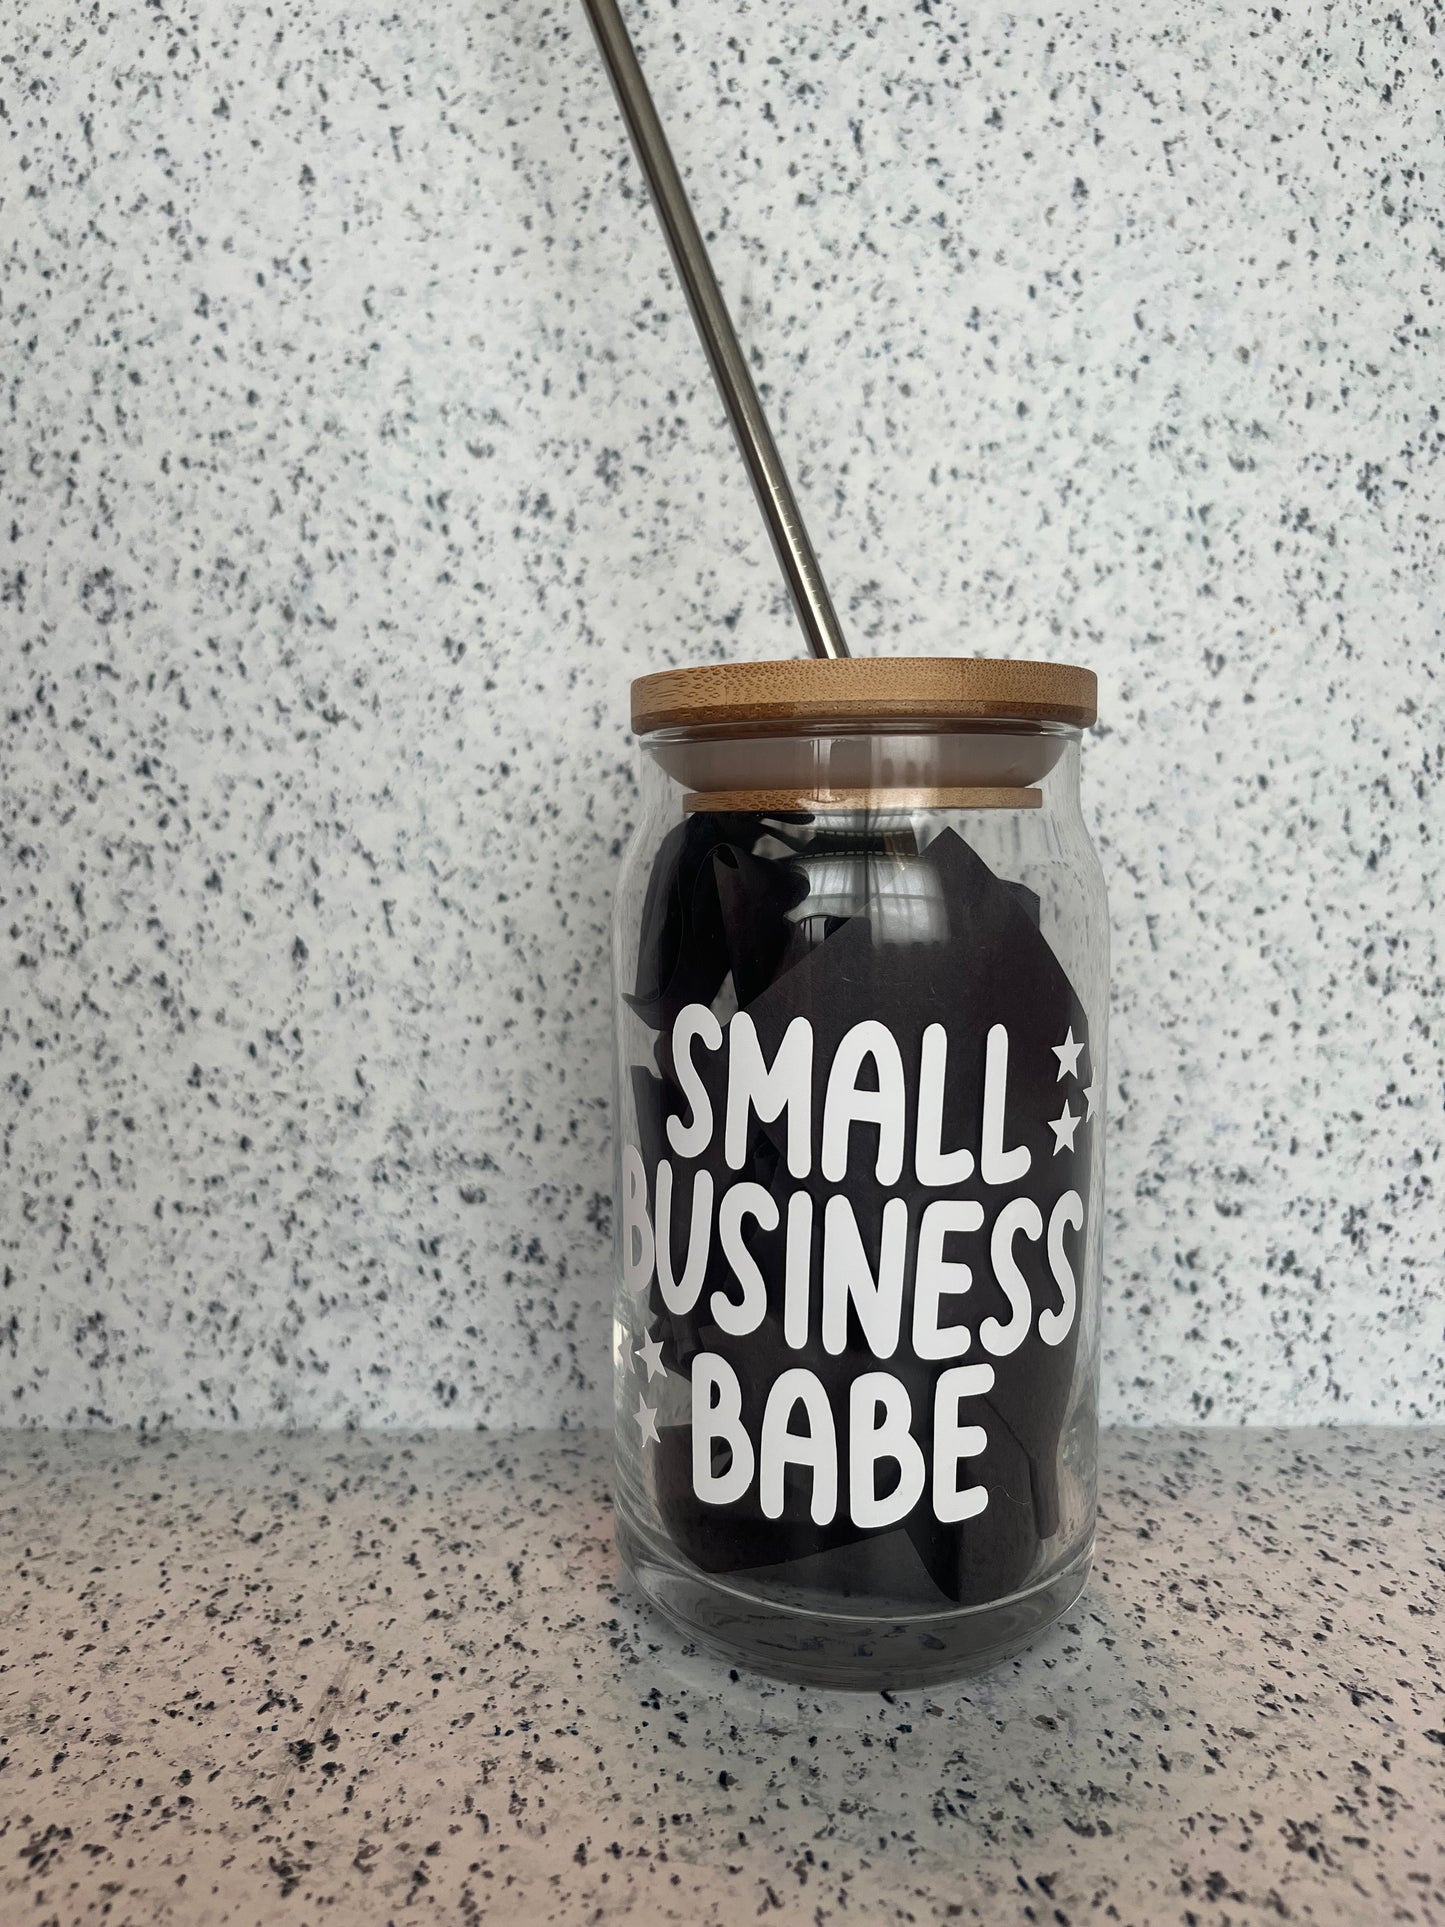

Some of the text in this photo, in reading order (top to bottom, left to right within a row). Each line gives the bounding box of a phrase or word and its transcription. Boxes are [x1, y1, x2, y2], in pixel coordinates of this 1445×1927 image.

[666, 1003, 1032, 1187] SMALL
[622, 1144, 1084, 1361] BUSINESS
[691, 1352, 996, 1529] BABE
